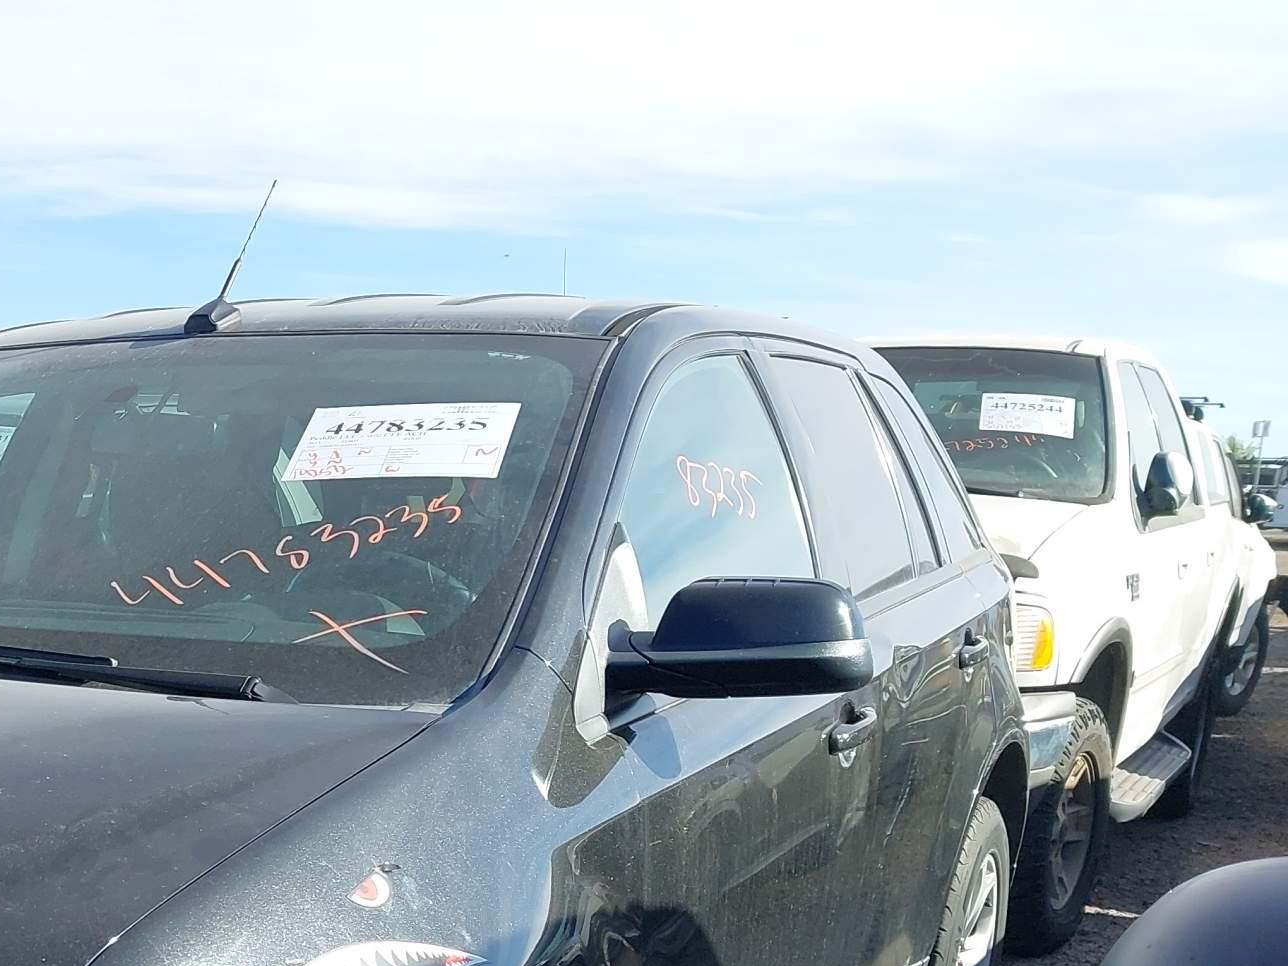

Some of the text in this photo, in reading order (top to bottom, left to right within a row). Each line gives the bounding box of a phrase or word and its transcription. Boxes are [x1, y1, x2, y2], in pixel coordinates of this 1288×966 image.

[325, 416, 490, 436] 44783235
[990, 402, 1064, 413] 44725244
[676, 455, 764, 519] 83235
[111, 494, 462, 606] 44783235
